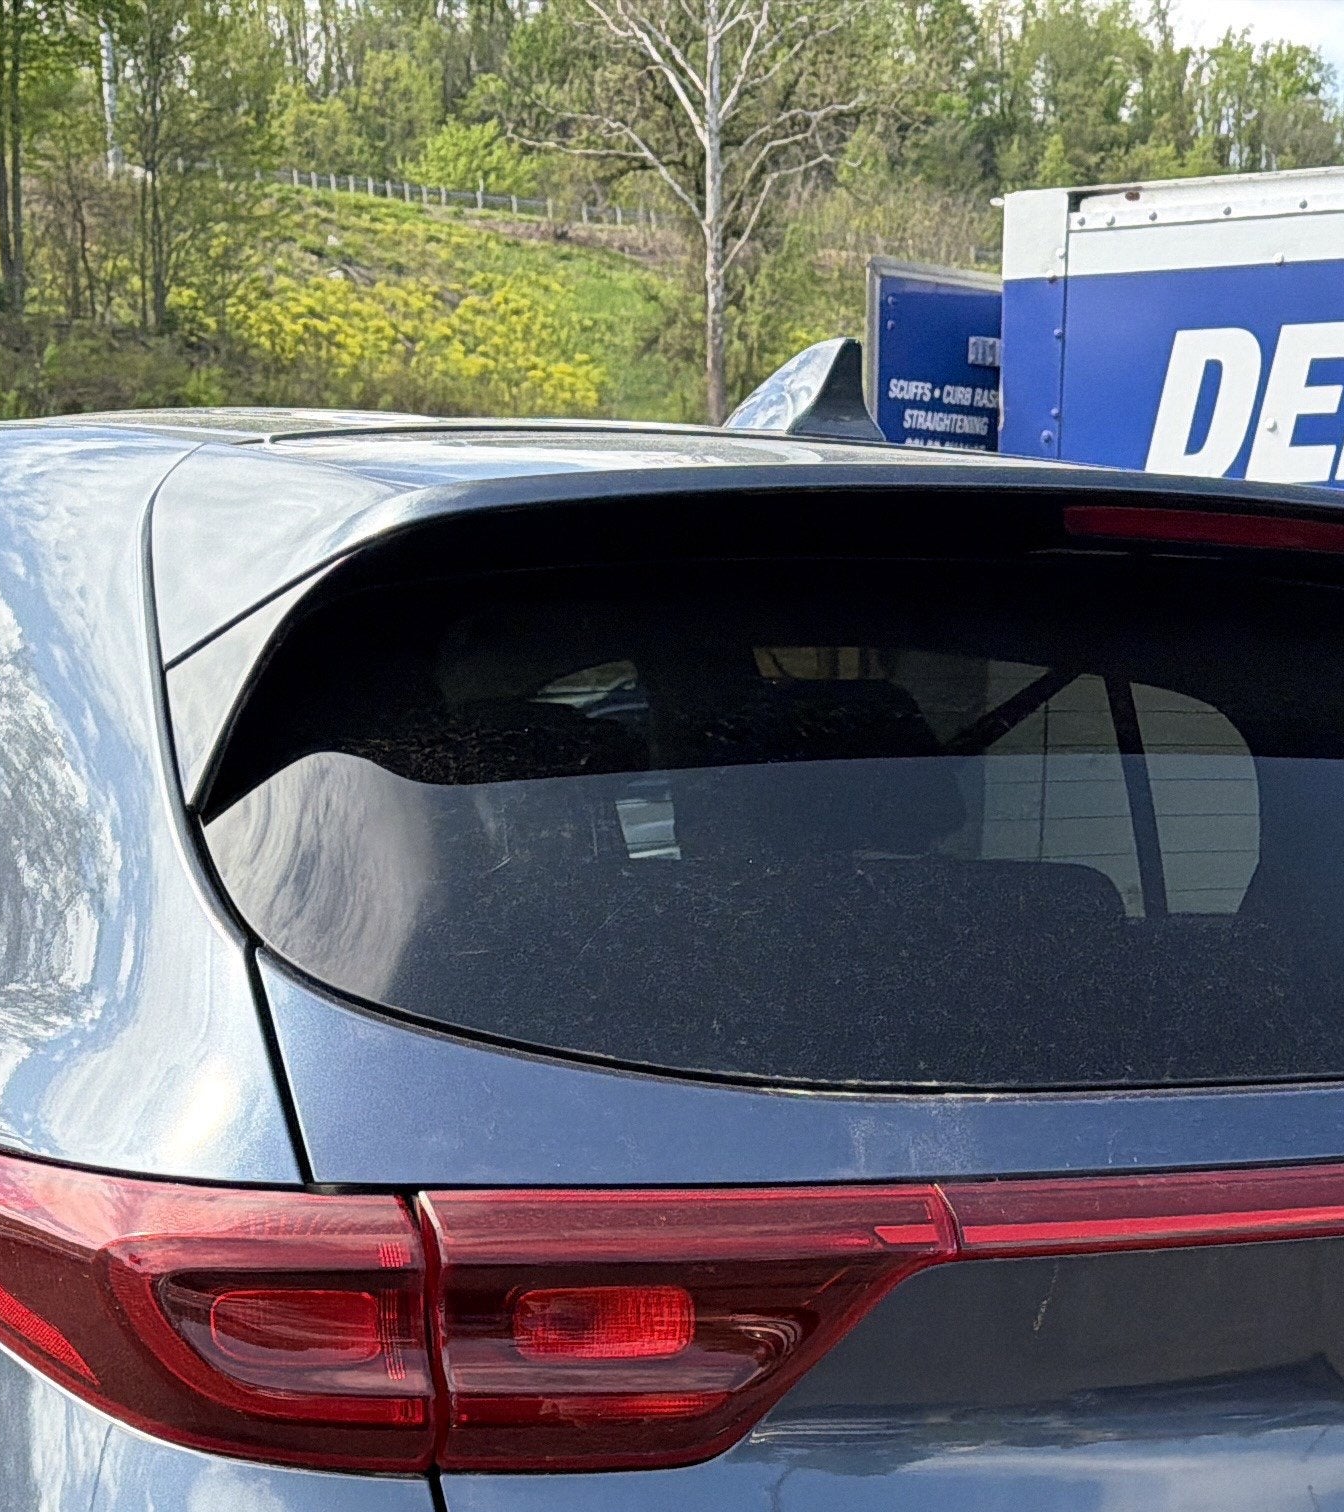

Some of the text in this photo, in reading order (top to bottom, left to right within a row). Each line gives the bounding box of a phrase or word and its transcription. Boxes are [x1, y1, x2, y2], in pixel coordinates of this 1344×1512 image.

[888, 378, 999, 408] SCUFFS CURB RAS
[903, 408, 989, 435] STRAIGHTENING
